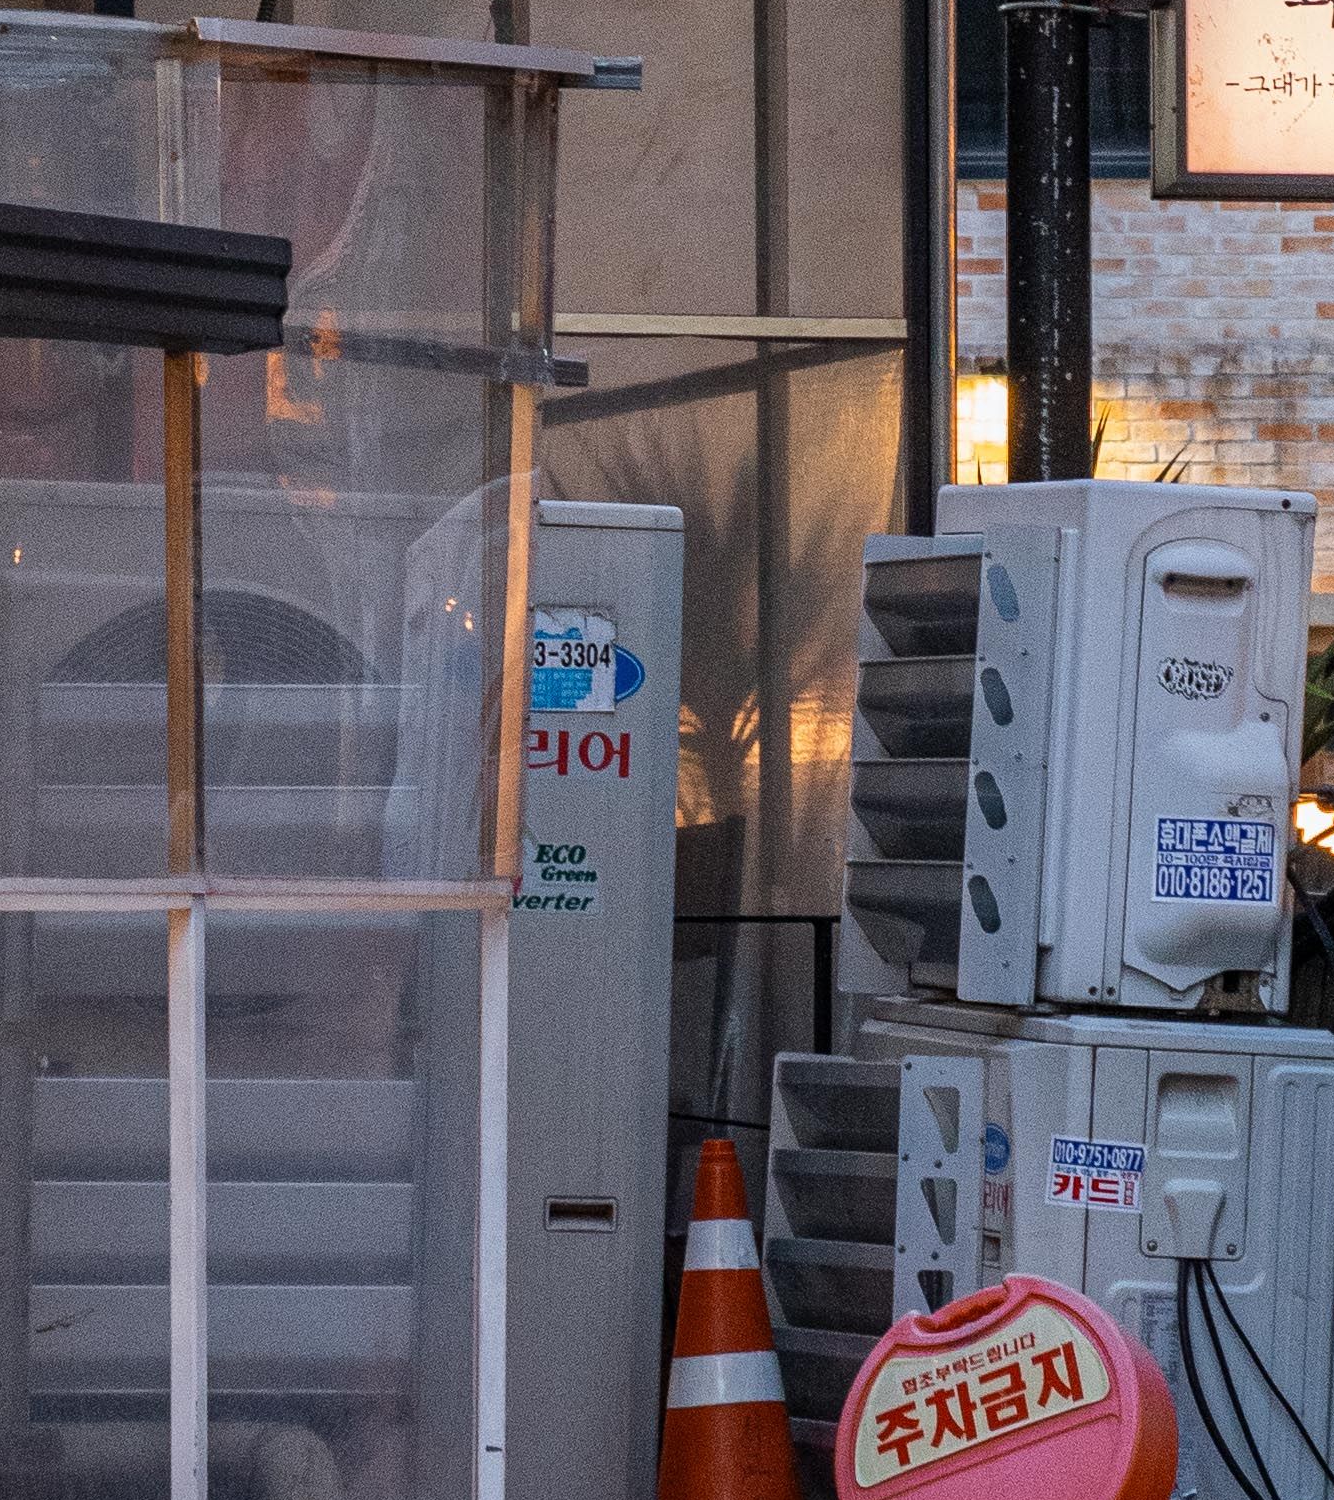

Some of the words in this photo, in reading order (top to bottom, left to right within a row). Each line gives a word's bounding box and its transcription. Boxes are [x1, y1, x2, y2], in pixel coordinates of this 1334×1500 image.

[1159, 819, 1273, 856] 휴대폰소액결제
[533, 843, 587, 865] ECO
[540, 865, 598, 884] Green
[1052, 1172, 1120, 1204] 카드
[875, 1340, 1085, 1467] 주차금지
